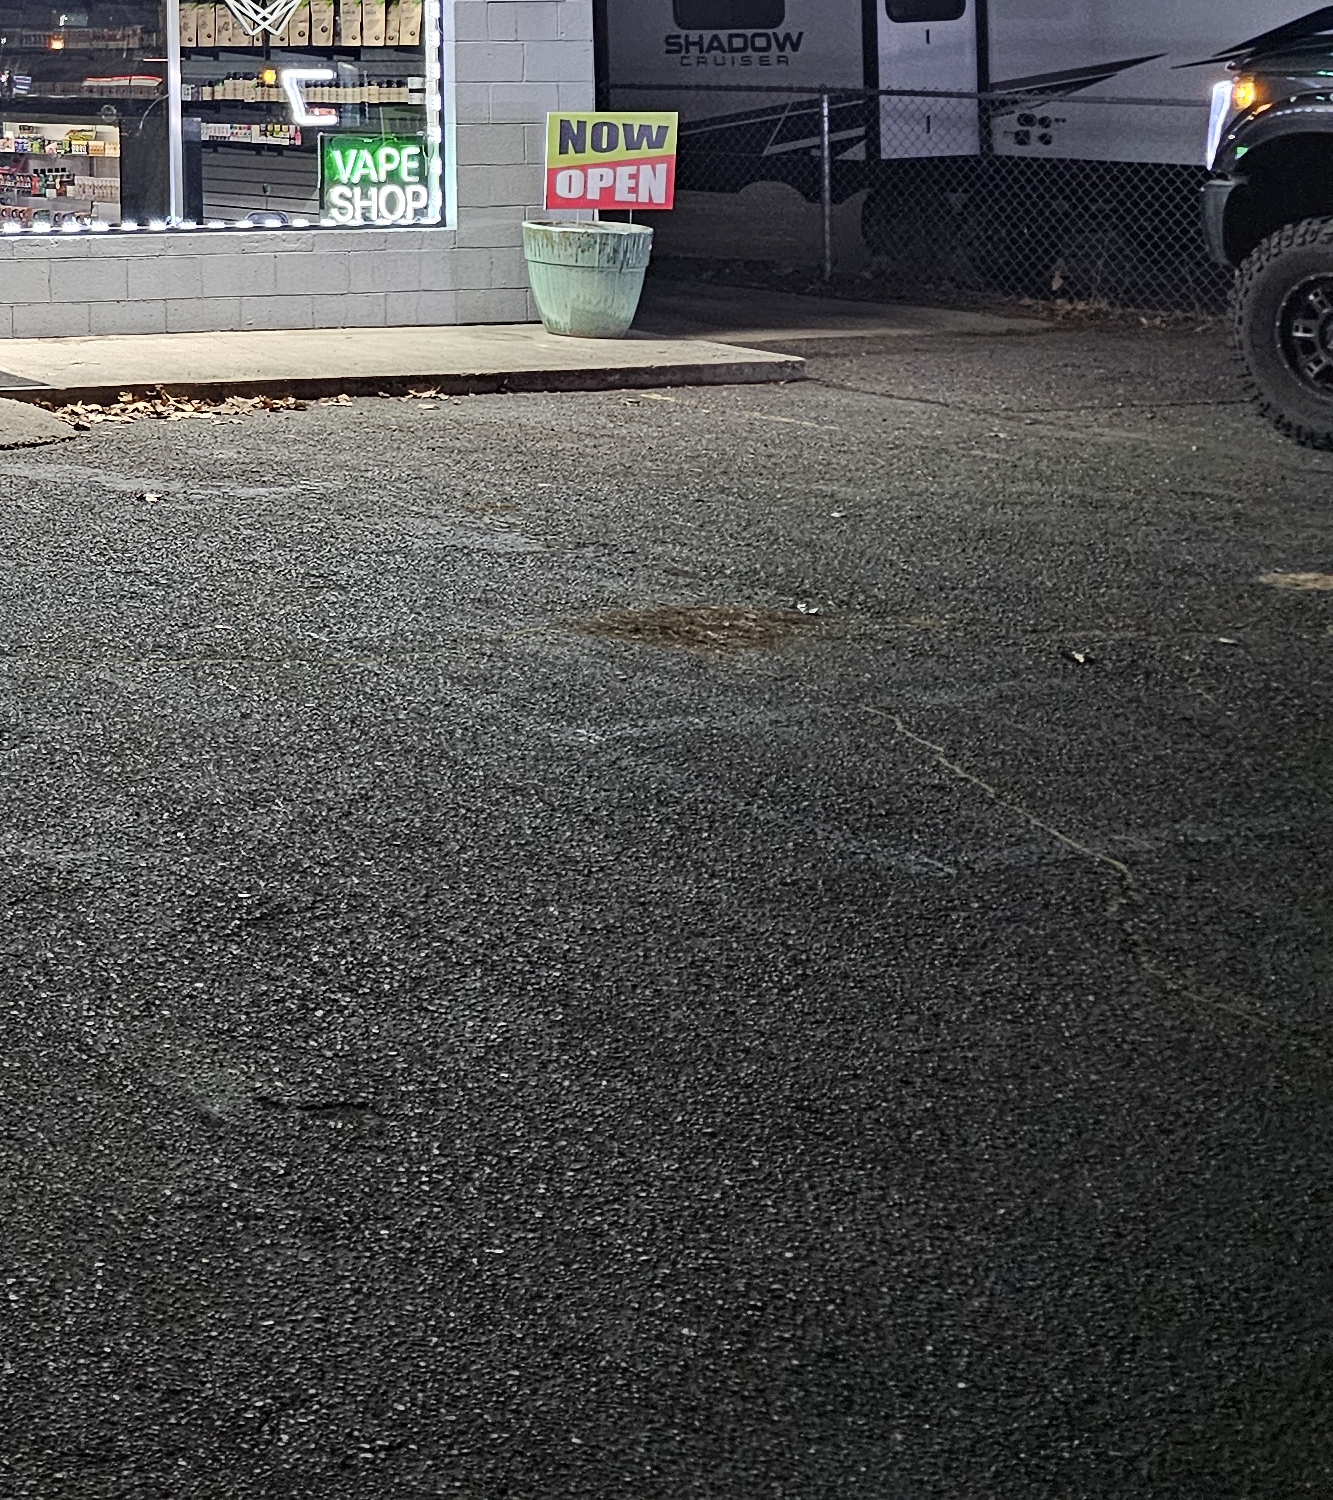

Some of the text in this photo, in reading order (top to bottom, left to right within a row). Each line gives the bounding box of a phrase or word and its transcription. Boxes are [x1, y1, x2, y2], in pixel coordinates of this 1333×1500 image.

[664, 31, 804, 55] SHADOW
[679, 55, 790, 67] CRUISER
[559, 119, 669, 155] NOW
[332, 146, 421, 185] VAPE
[555, 163, 668, 204] OPEN
[328, 184, 428, 223] SHOP
